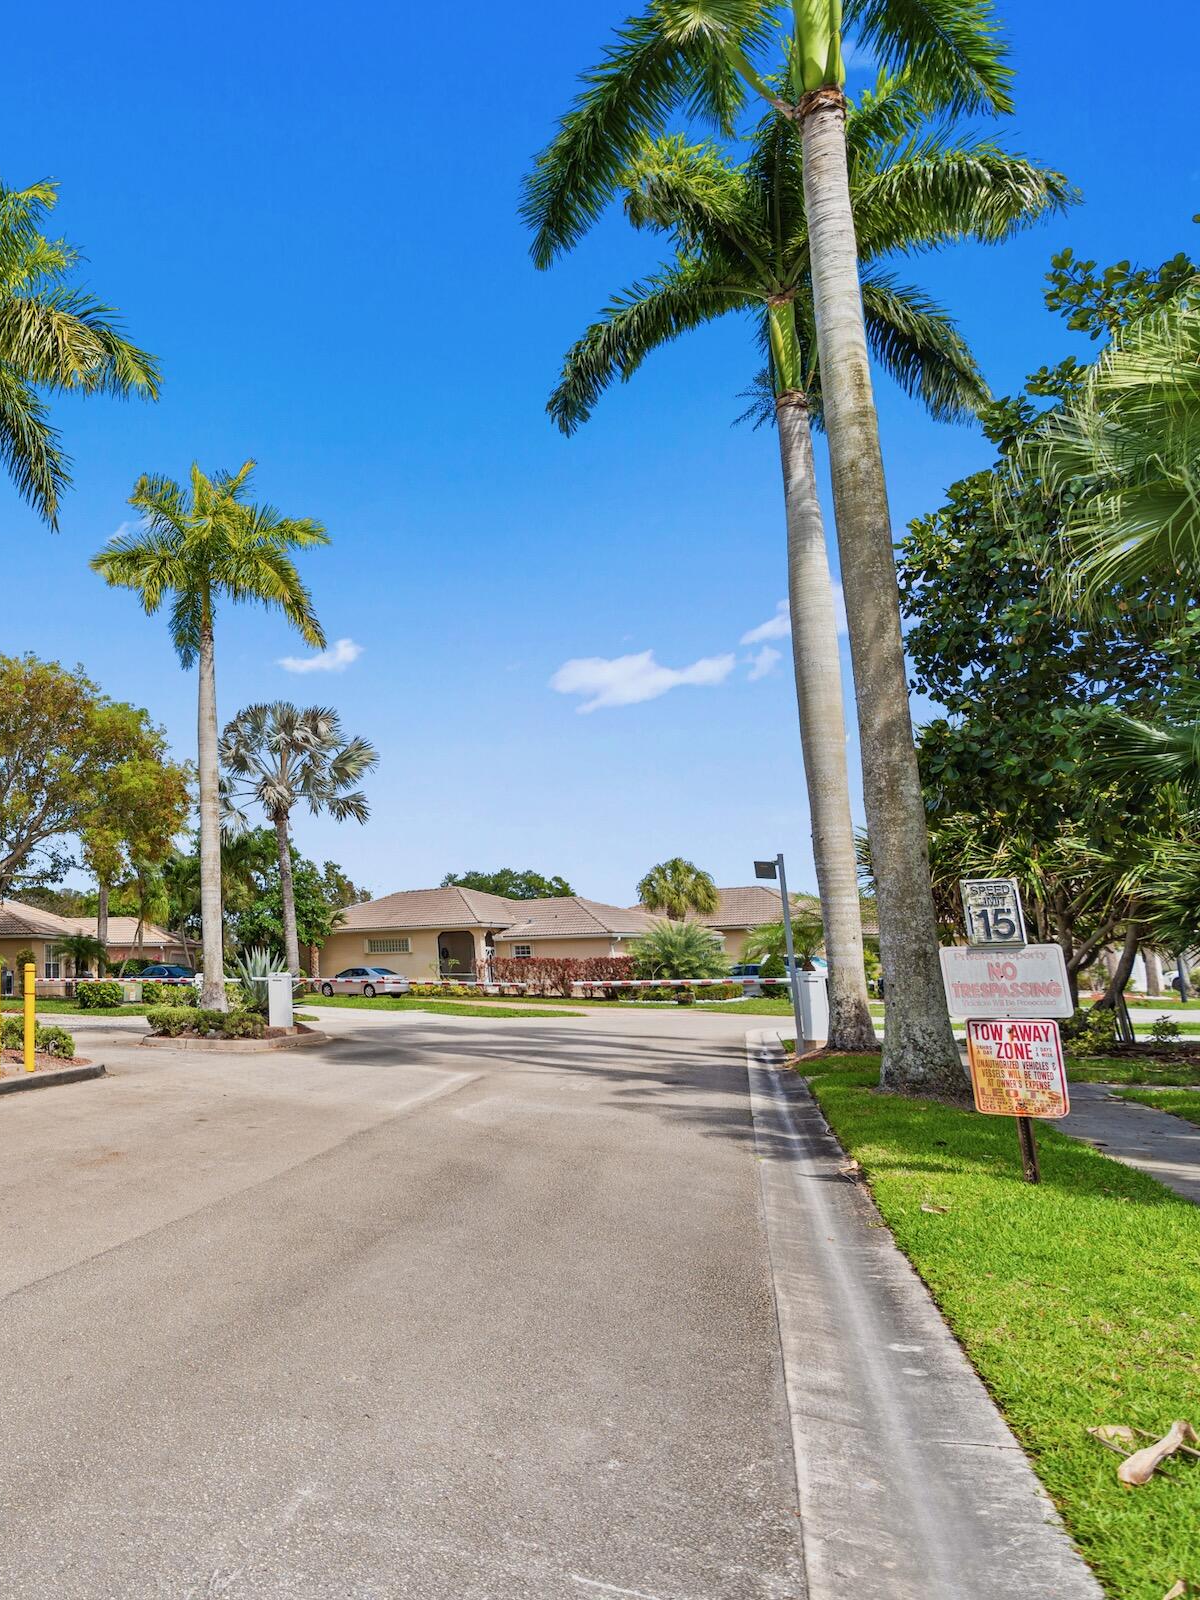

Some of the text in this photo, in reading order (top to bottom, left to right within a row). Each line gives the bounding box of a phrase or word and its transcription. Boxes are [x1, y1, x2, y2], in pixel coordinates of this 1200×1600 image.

[969, 885, 1010, 896] SPEED
[976, 908, 1016, 940] 15
[997, 950, 1048, 961] Property
[987, 961, 1018, 981] NO
[951, 981, 1063, 999] TRESPASSING
[972, 1023, 1050, 1042] TOW AWAY
[995, 1042, 1034, 1060] ZONE
[976, 1059, 1020, 1070] UNAUTHORIZED
[1022, 1061, 1050, 1071] VEHICLES
[981, 1069, 1054, 1081] VESSELS WILL BE TOWED
[987, 1078, 1052, 1090] AT OWNER'S EXPENSE
[980, 1087, 1019, 1097] LEO
